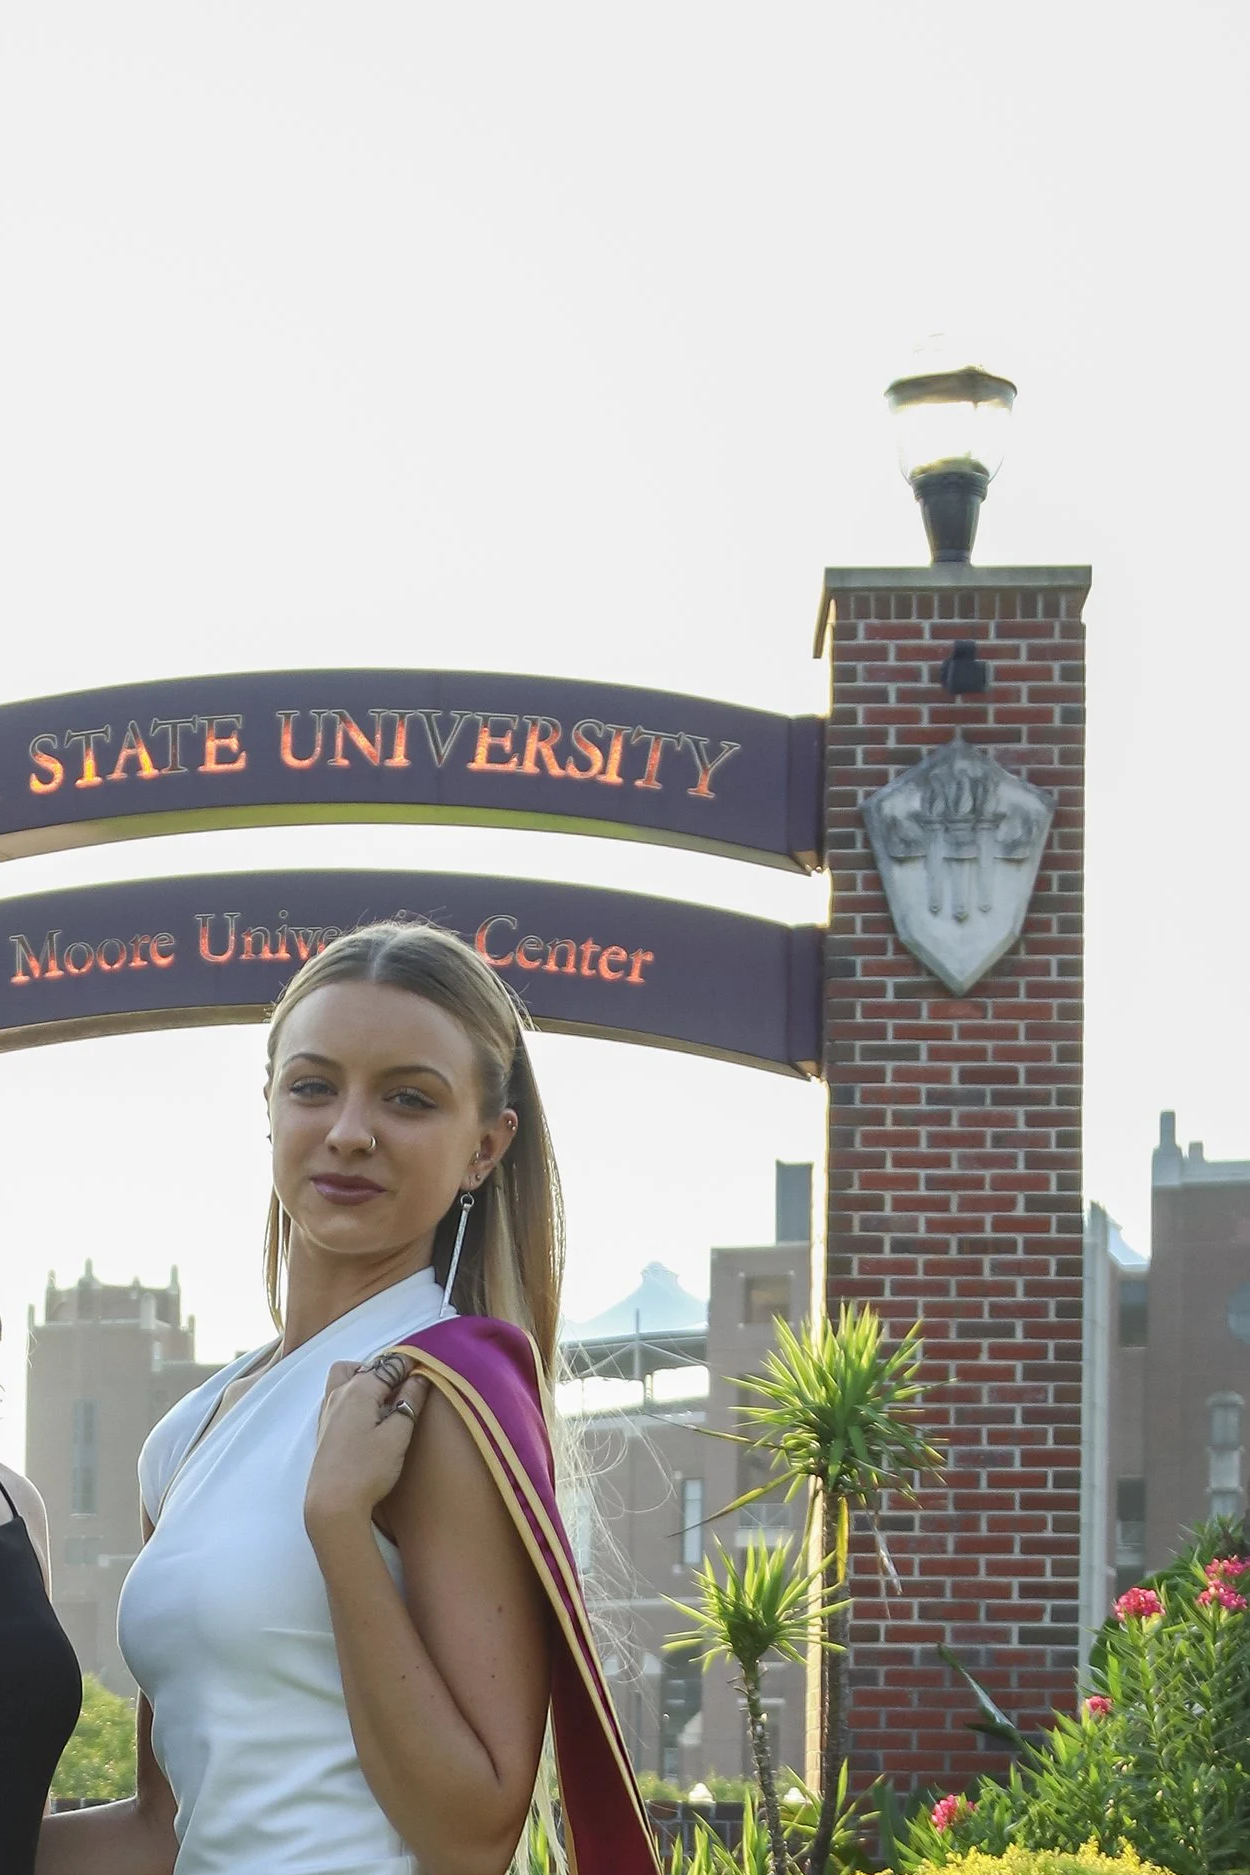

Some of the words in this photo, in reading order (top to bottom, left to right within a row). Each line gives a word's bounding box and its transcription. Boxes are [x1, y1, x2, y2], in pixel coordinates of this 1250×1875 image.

[28, 714, 247, 795] STATE
[276, 709, 741, 799] UNIVERSITY
[8, 929, 176, 986] Moore
[195, 908, 408, 962] Unive
[473, 914, 655, 985] Center
